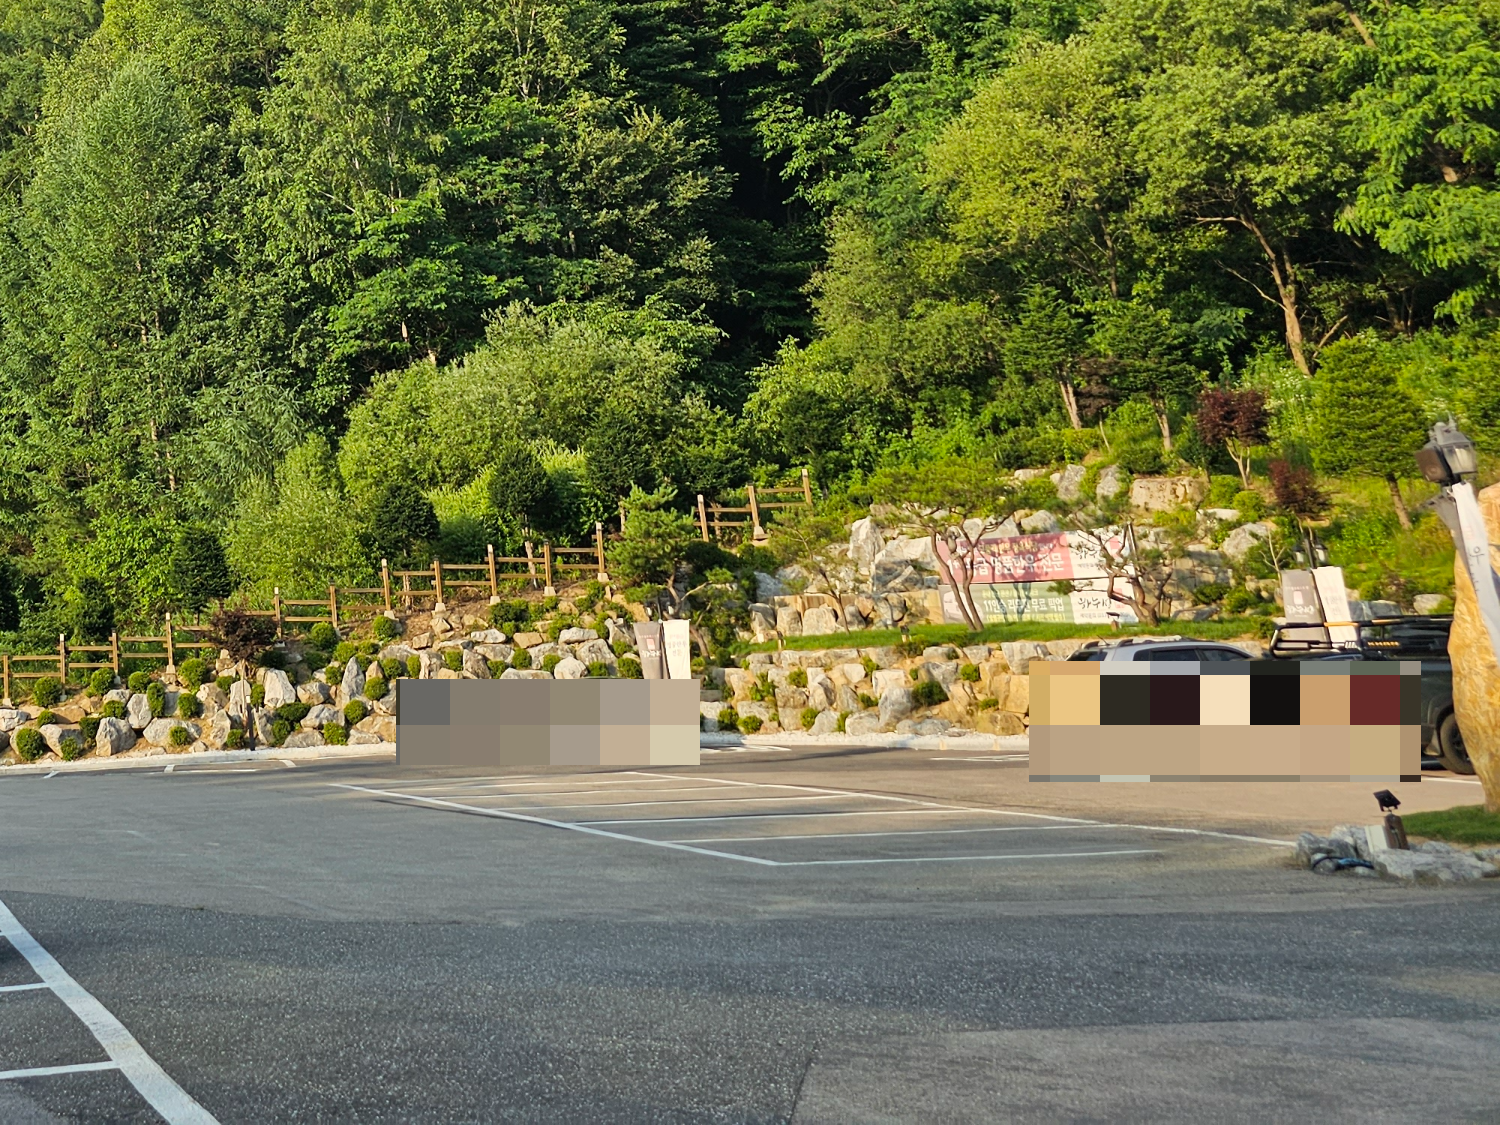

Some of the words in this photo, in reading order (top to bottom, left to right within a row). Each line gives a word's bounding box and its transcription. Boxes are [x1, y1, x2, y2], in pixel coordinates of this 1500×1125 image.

[1038, 552, 1064, 572] 전문
[1031, 598, 1048, 612] 무료
[1048, 597, 1065, 612] 픽업
